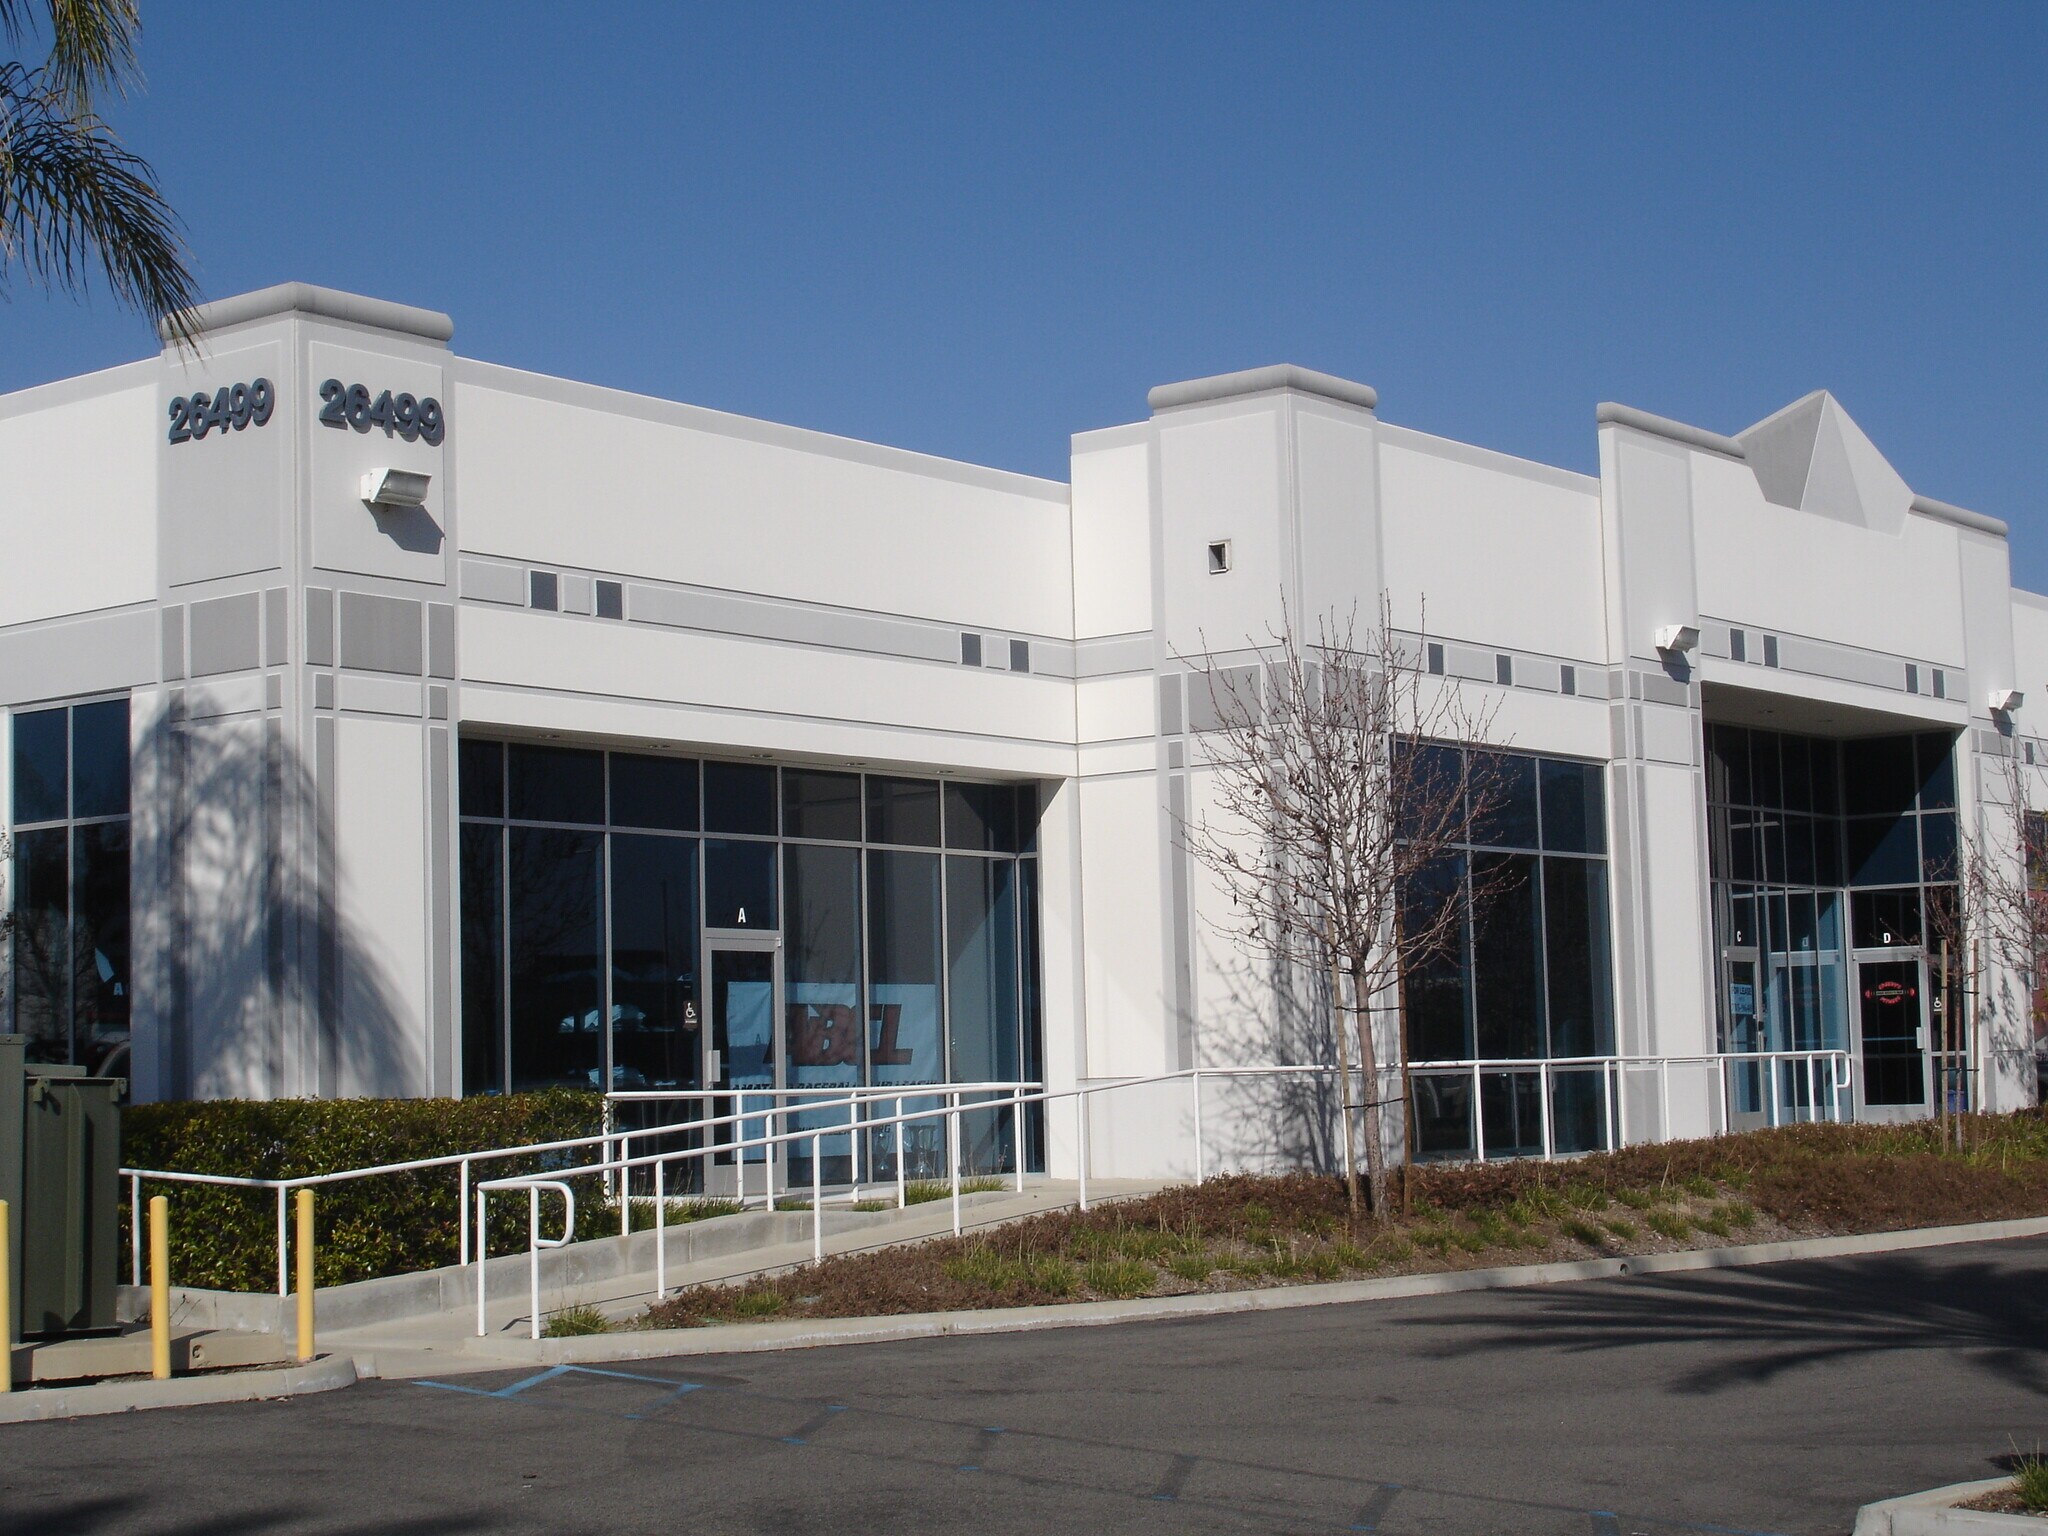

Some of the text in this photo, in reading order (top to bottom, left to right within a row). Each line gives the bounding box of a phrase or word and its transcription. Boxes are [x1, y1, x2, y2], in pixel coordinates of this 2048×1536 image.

[168, 377, 275, 445] 26499
[319, 378, 445, 447] 26499
[737, 907, 746, 923] A
[1736, 930, 1742, 943] C
[1883, 932, 1891, 944] D
